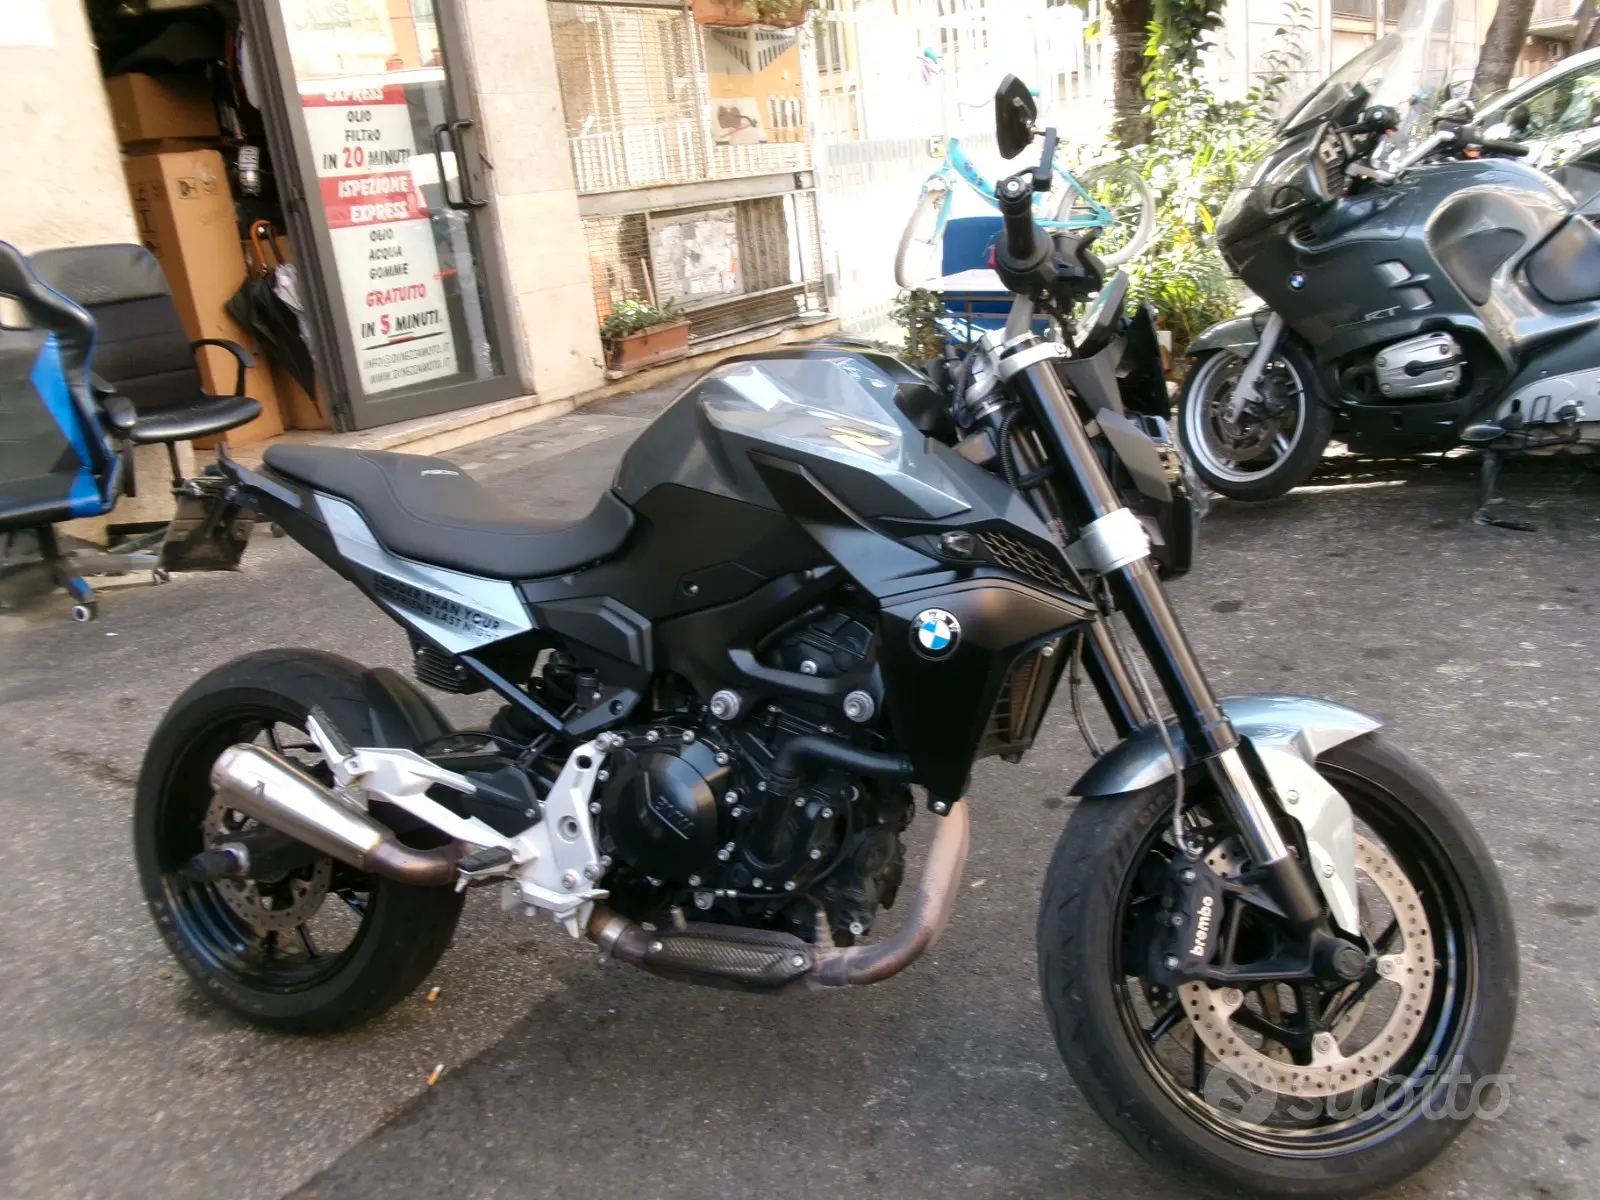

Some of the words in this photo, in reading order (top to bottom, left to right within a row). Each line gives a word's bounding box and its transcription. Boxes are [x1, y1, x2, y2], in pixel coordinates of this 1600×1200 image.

[347, 110, 372, 123] OLIO
[345, 128, 381, 142] FILTRO
[323, 154, 338, 170] IN
[343, 146, 364, 169] 20
[338, 175, 409, 198] ISPEZIONE
[349, 201, 408, 223] EXPRESS
[369, 228, 394, 242] OLIO
[369, 246, 403, 261] ACQUA
[369, 263, 409, 279] GOMME
[366, 283, 427, 307] GRATUITO
[361, 322, 375, 339] IN
[380, 314, 391, 335] 5
[424, 594, 460, 614] THAN
[463, 609, 501, 630] YOUR
[435, 611, 461, 627] LAST
[1189, 896, 1214, 957] brembo
